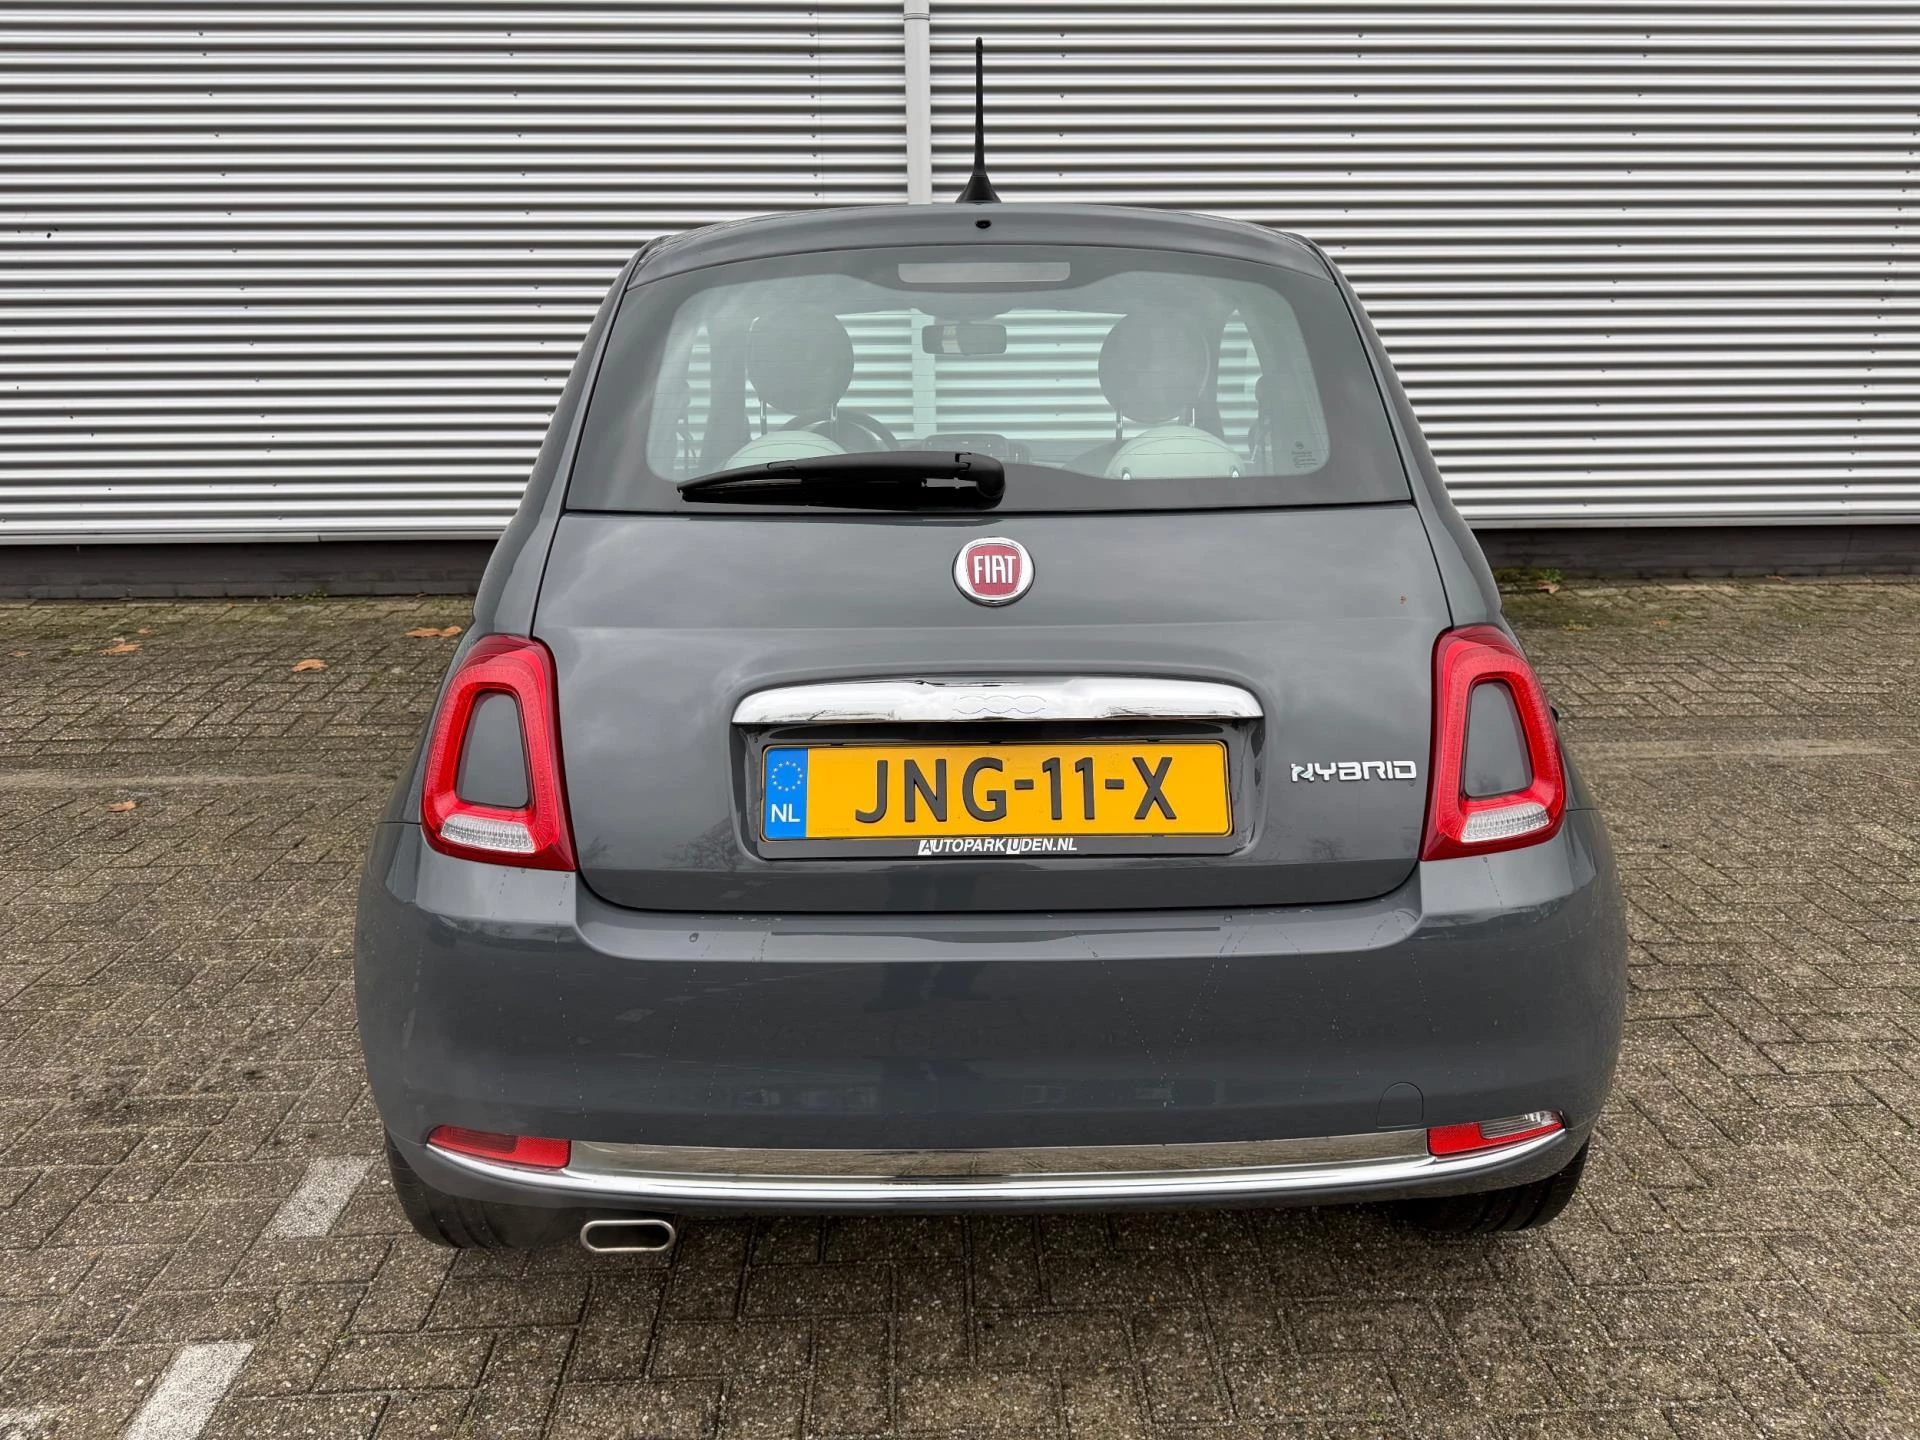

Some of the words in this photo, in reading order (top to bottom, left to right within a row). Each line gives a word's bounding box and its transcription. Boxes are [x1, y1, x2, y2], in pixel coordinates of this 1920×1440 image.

[973, 555, 1016, 584] FIAT
[1291, 760, 1417, 782] HYBRID
[855, 757, 1177, 823] JNG-11-X
[771, 803, 801, 823] NL
[918, 837, 1077, 856] AUTOPARKUDEN.NL
